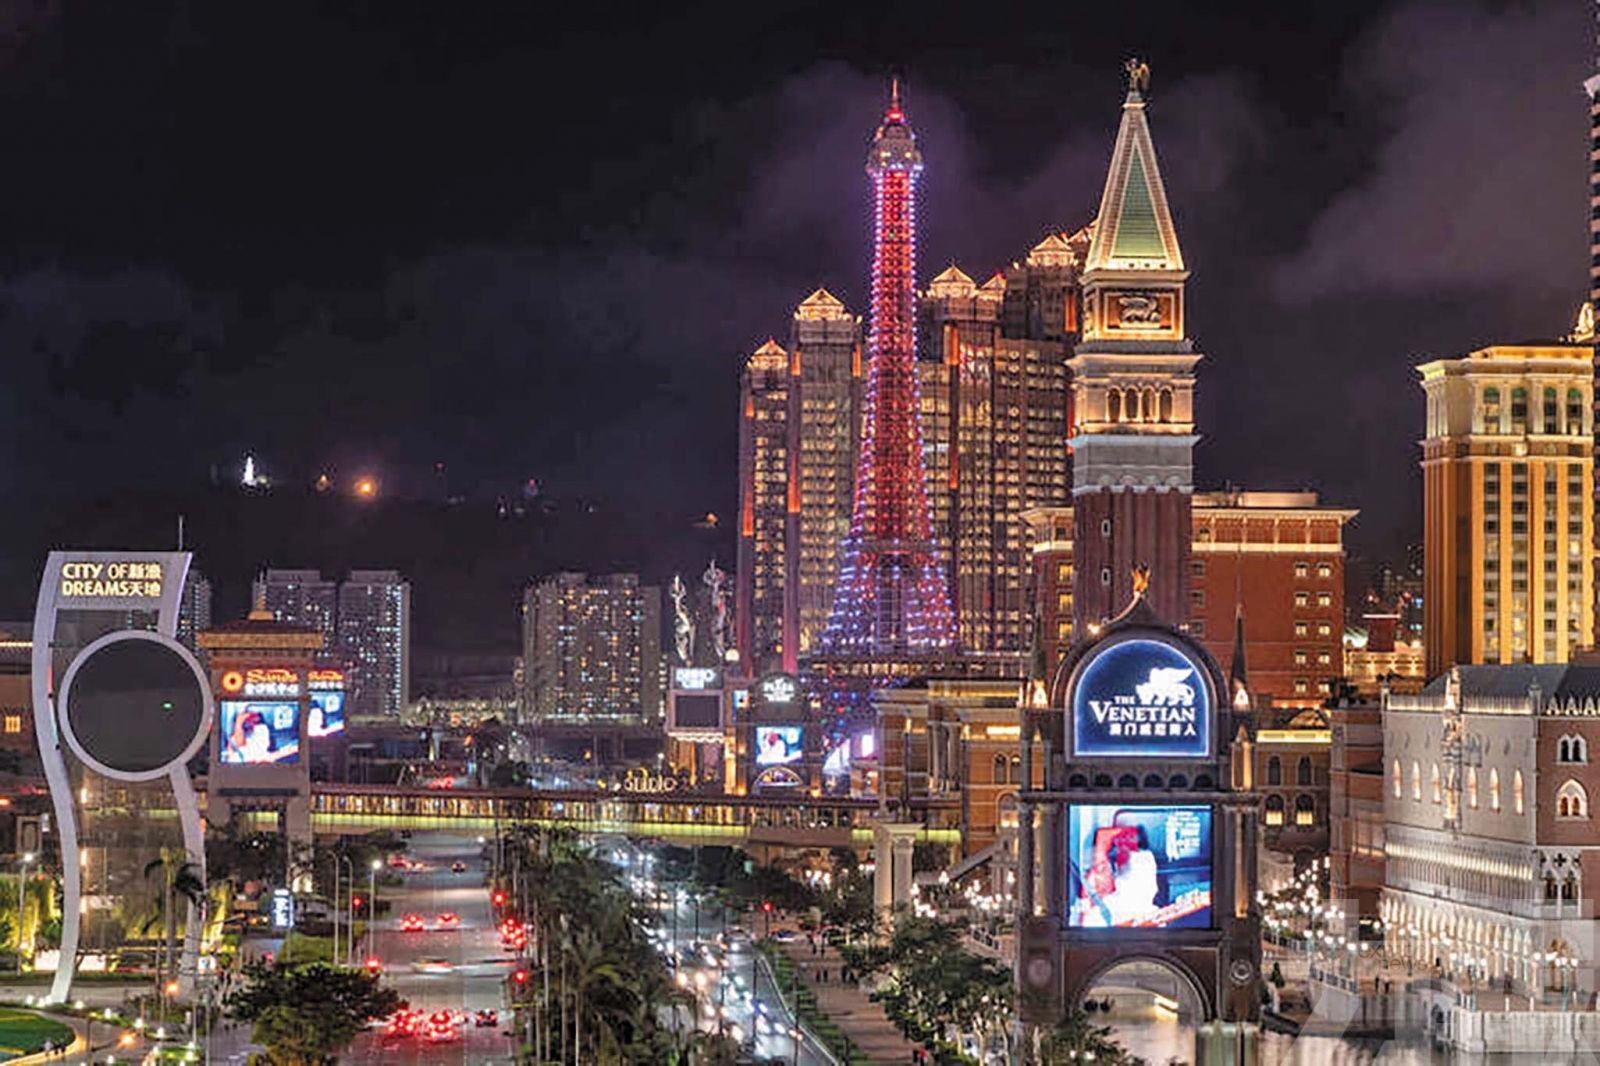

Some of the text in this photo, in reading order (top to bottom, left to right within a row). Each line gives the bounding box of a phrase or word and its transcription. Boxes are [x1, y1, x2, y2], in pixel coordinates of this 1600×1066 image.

[62, 563, 128, 579] CITY OF
[62, 581, 128, 596] DREAMS
[128, 581, 161, 597] 天地
[1114, 696, 1135, 705] THE
[1088, 700, 1195, 724] VENETIAN
